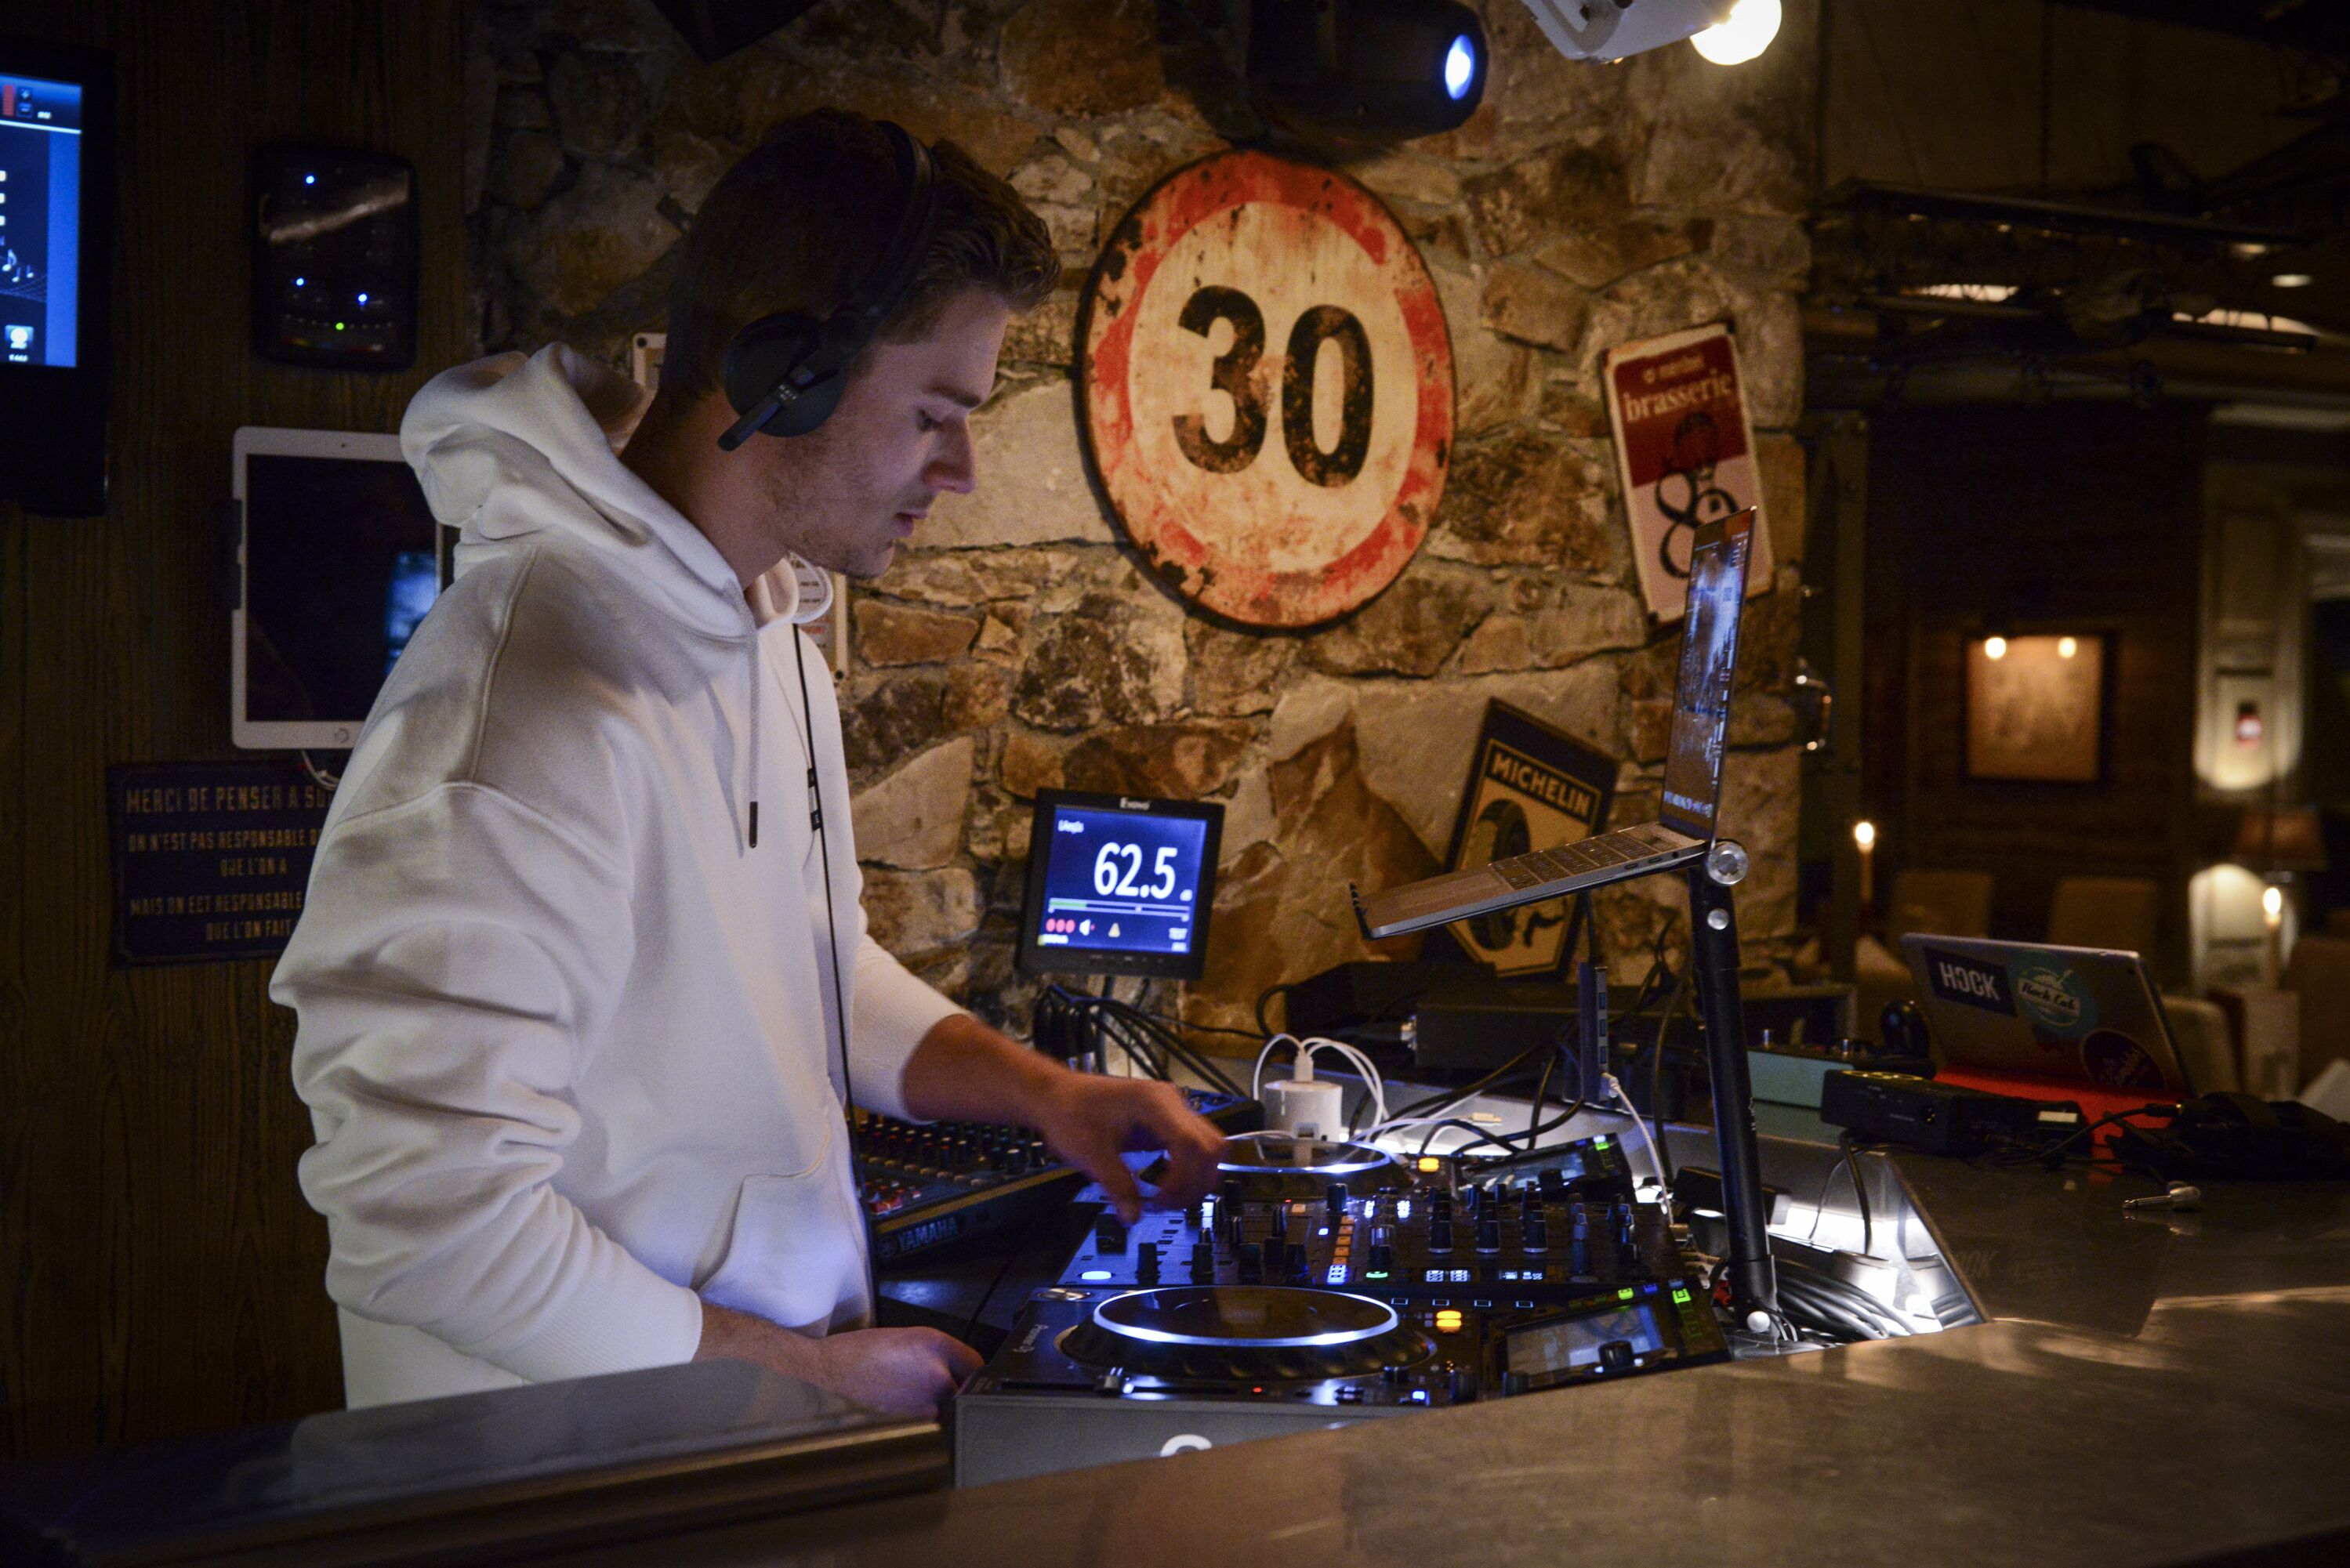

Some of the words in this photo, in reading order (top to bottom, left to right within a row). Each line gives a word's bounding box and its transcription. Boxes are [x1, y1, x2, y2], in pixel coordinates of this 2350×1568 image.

[1173, 284, 1374, 488] 30
[1492, 752, 1590, 817] MICHELIN
[126, 788, 183, 814] MERCI
[188, 786, 209, 813] DE
[216, 785, 283, 812] PENSER
[128, 833, 147, 853] ON
[190, 831, 215, 852] PAS
[218, 828, 306, 850] RESPONSABLE
[1093, 842, 1177, 900] 62.5
[129, 896, 164, 917] MAIS
[215, 890, 303, 913] RESPONSABLE
[264, 918, 292, 938] FAIT
